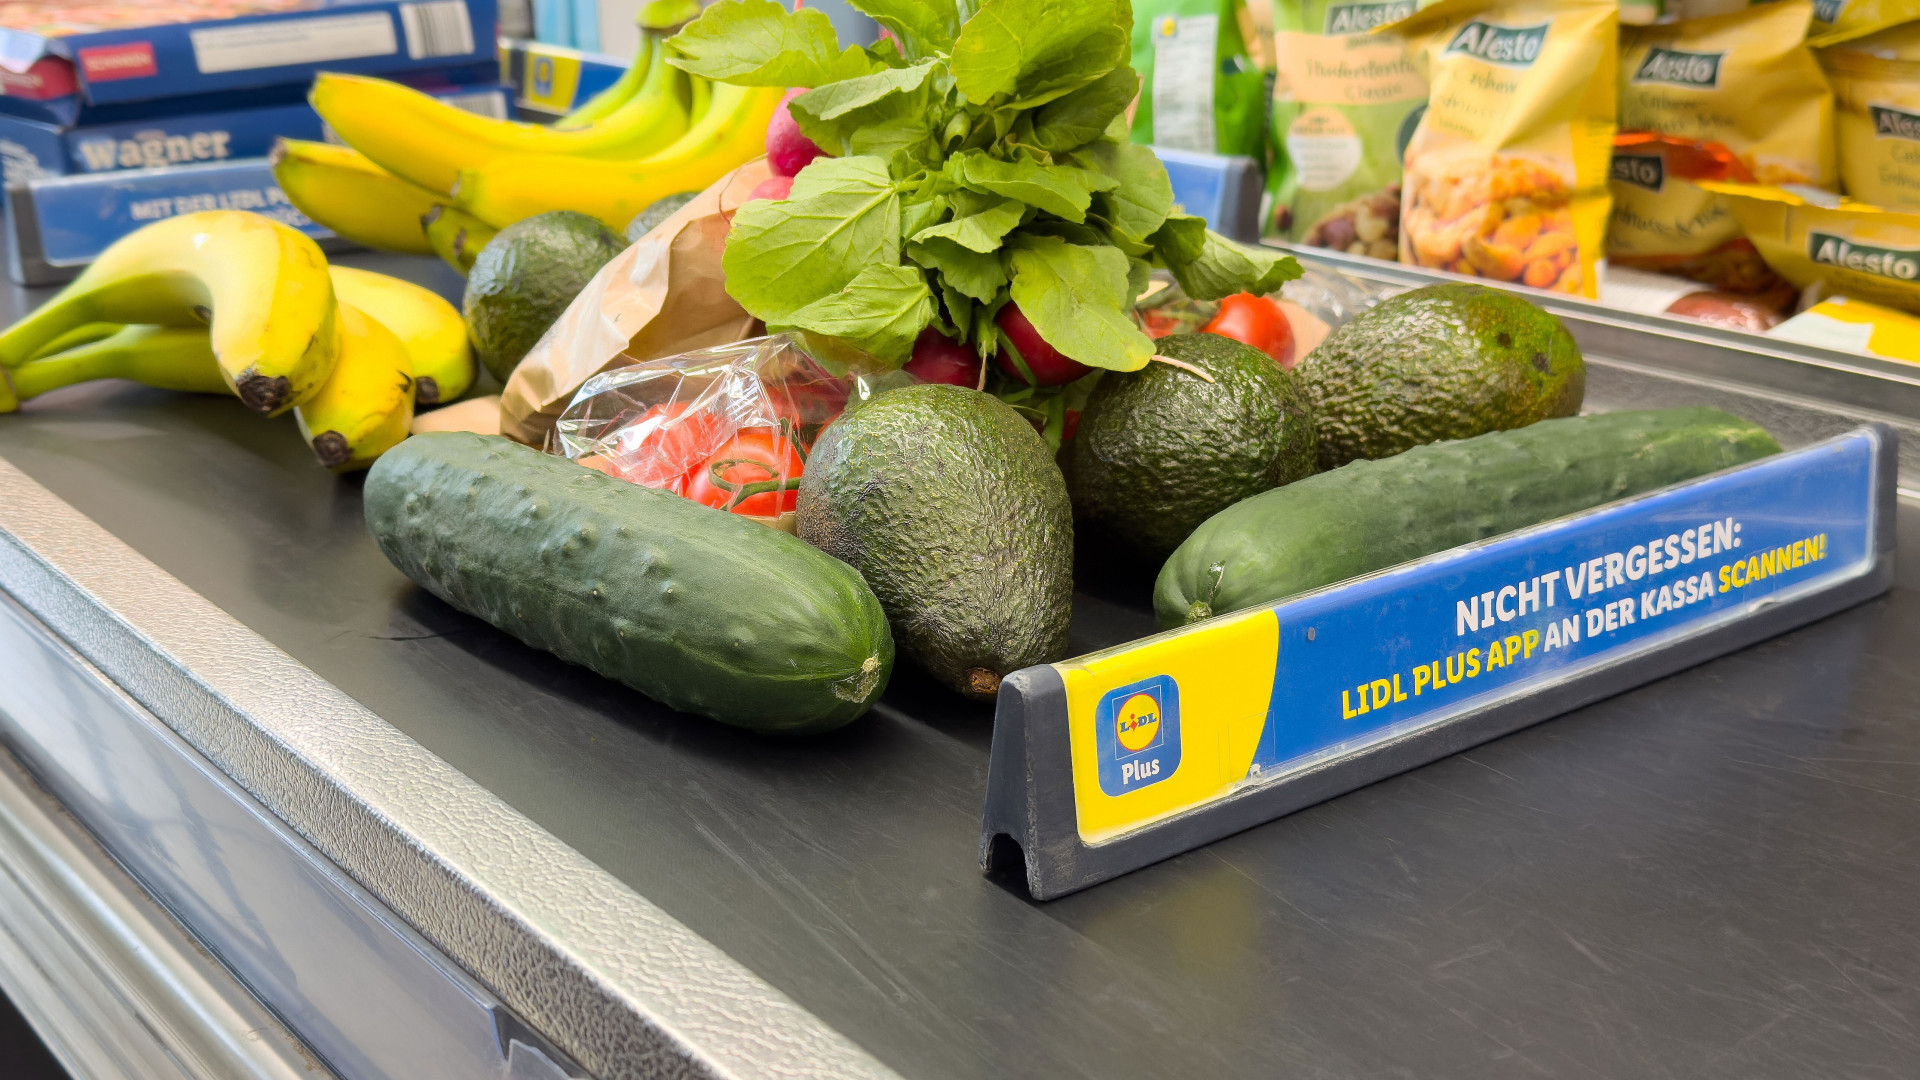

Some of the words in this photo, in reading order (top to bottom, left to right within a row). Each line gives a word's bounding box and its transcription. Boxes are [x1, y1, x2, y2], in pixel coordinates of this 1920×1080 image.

[1332, 3, 1410, 32] Alesto
[1451, 24, 1538, 61] Alesto
[1640, 52, 1713, 83] Alesto
[80, 131, 230, 169] Wagner
[131, 201, 171, 220] MIT
[1816, 238, 1918, 280] Alesto
[1456, 571, 1559, 636] NICHT
[1565, 517, 1742, 600] VERGESSEN:
[1342, 674, 1407, 719] LIDL
[1412, 648, 1481, 696] PLUS
[1486, 629, 1539, 672] APP
[1544, 614, 1580, 652] AN
[1586, 598, 1635, 638] DER
[1640, 571, 1714, 619] KASSA
[1718, 533, 1827, 593] SCANNEN!
[1122, 759, 1160, 785] Plus
